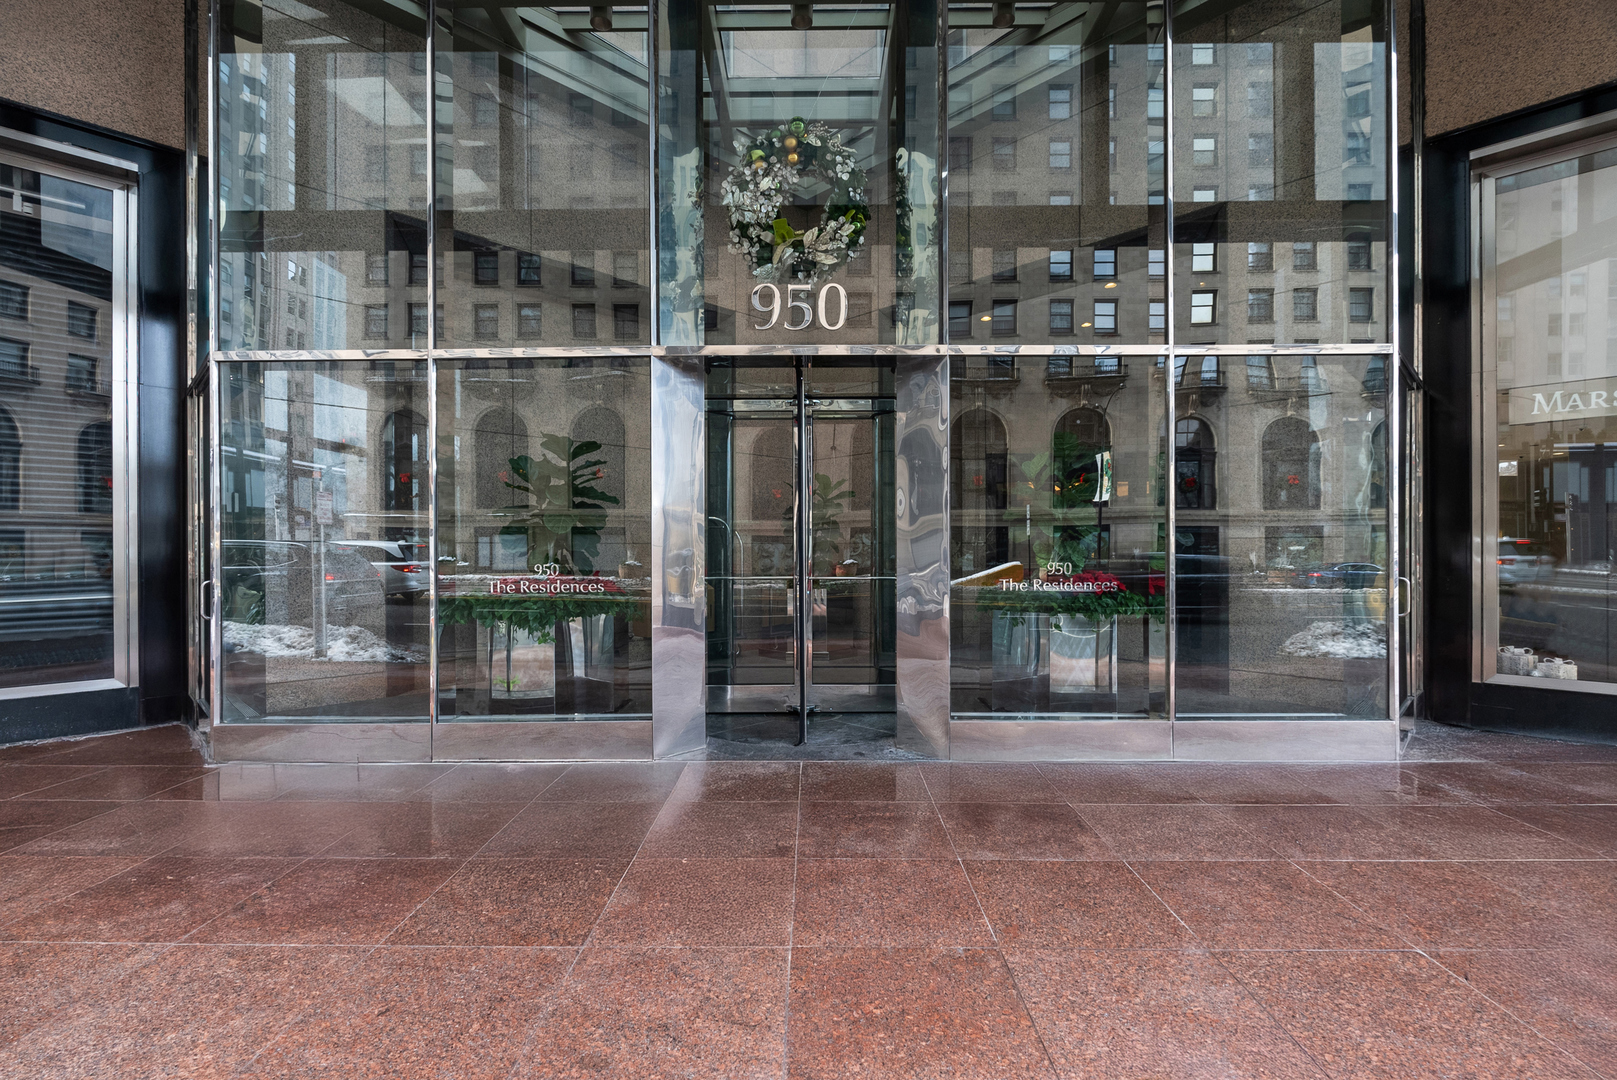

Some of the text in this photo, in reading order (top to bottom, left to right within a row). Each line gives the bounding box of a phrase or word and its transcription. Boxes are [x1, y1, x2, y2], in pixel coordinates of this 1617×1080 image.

[751, 283, 849, 331] 950
[533, 563, 559, 577] 950
[1047, 562, 1073, 575] 950
[489, 579, 605, 593] The Residences
[998, 578, 1119, 592] The Residences
